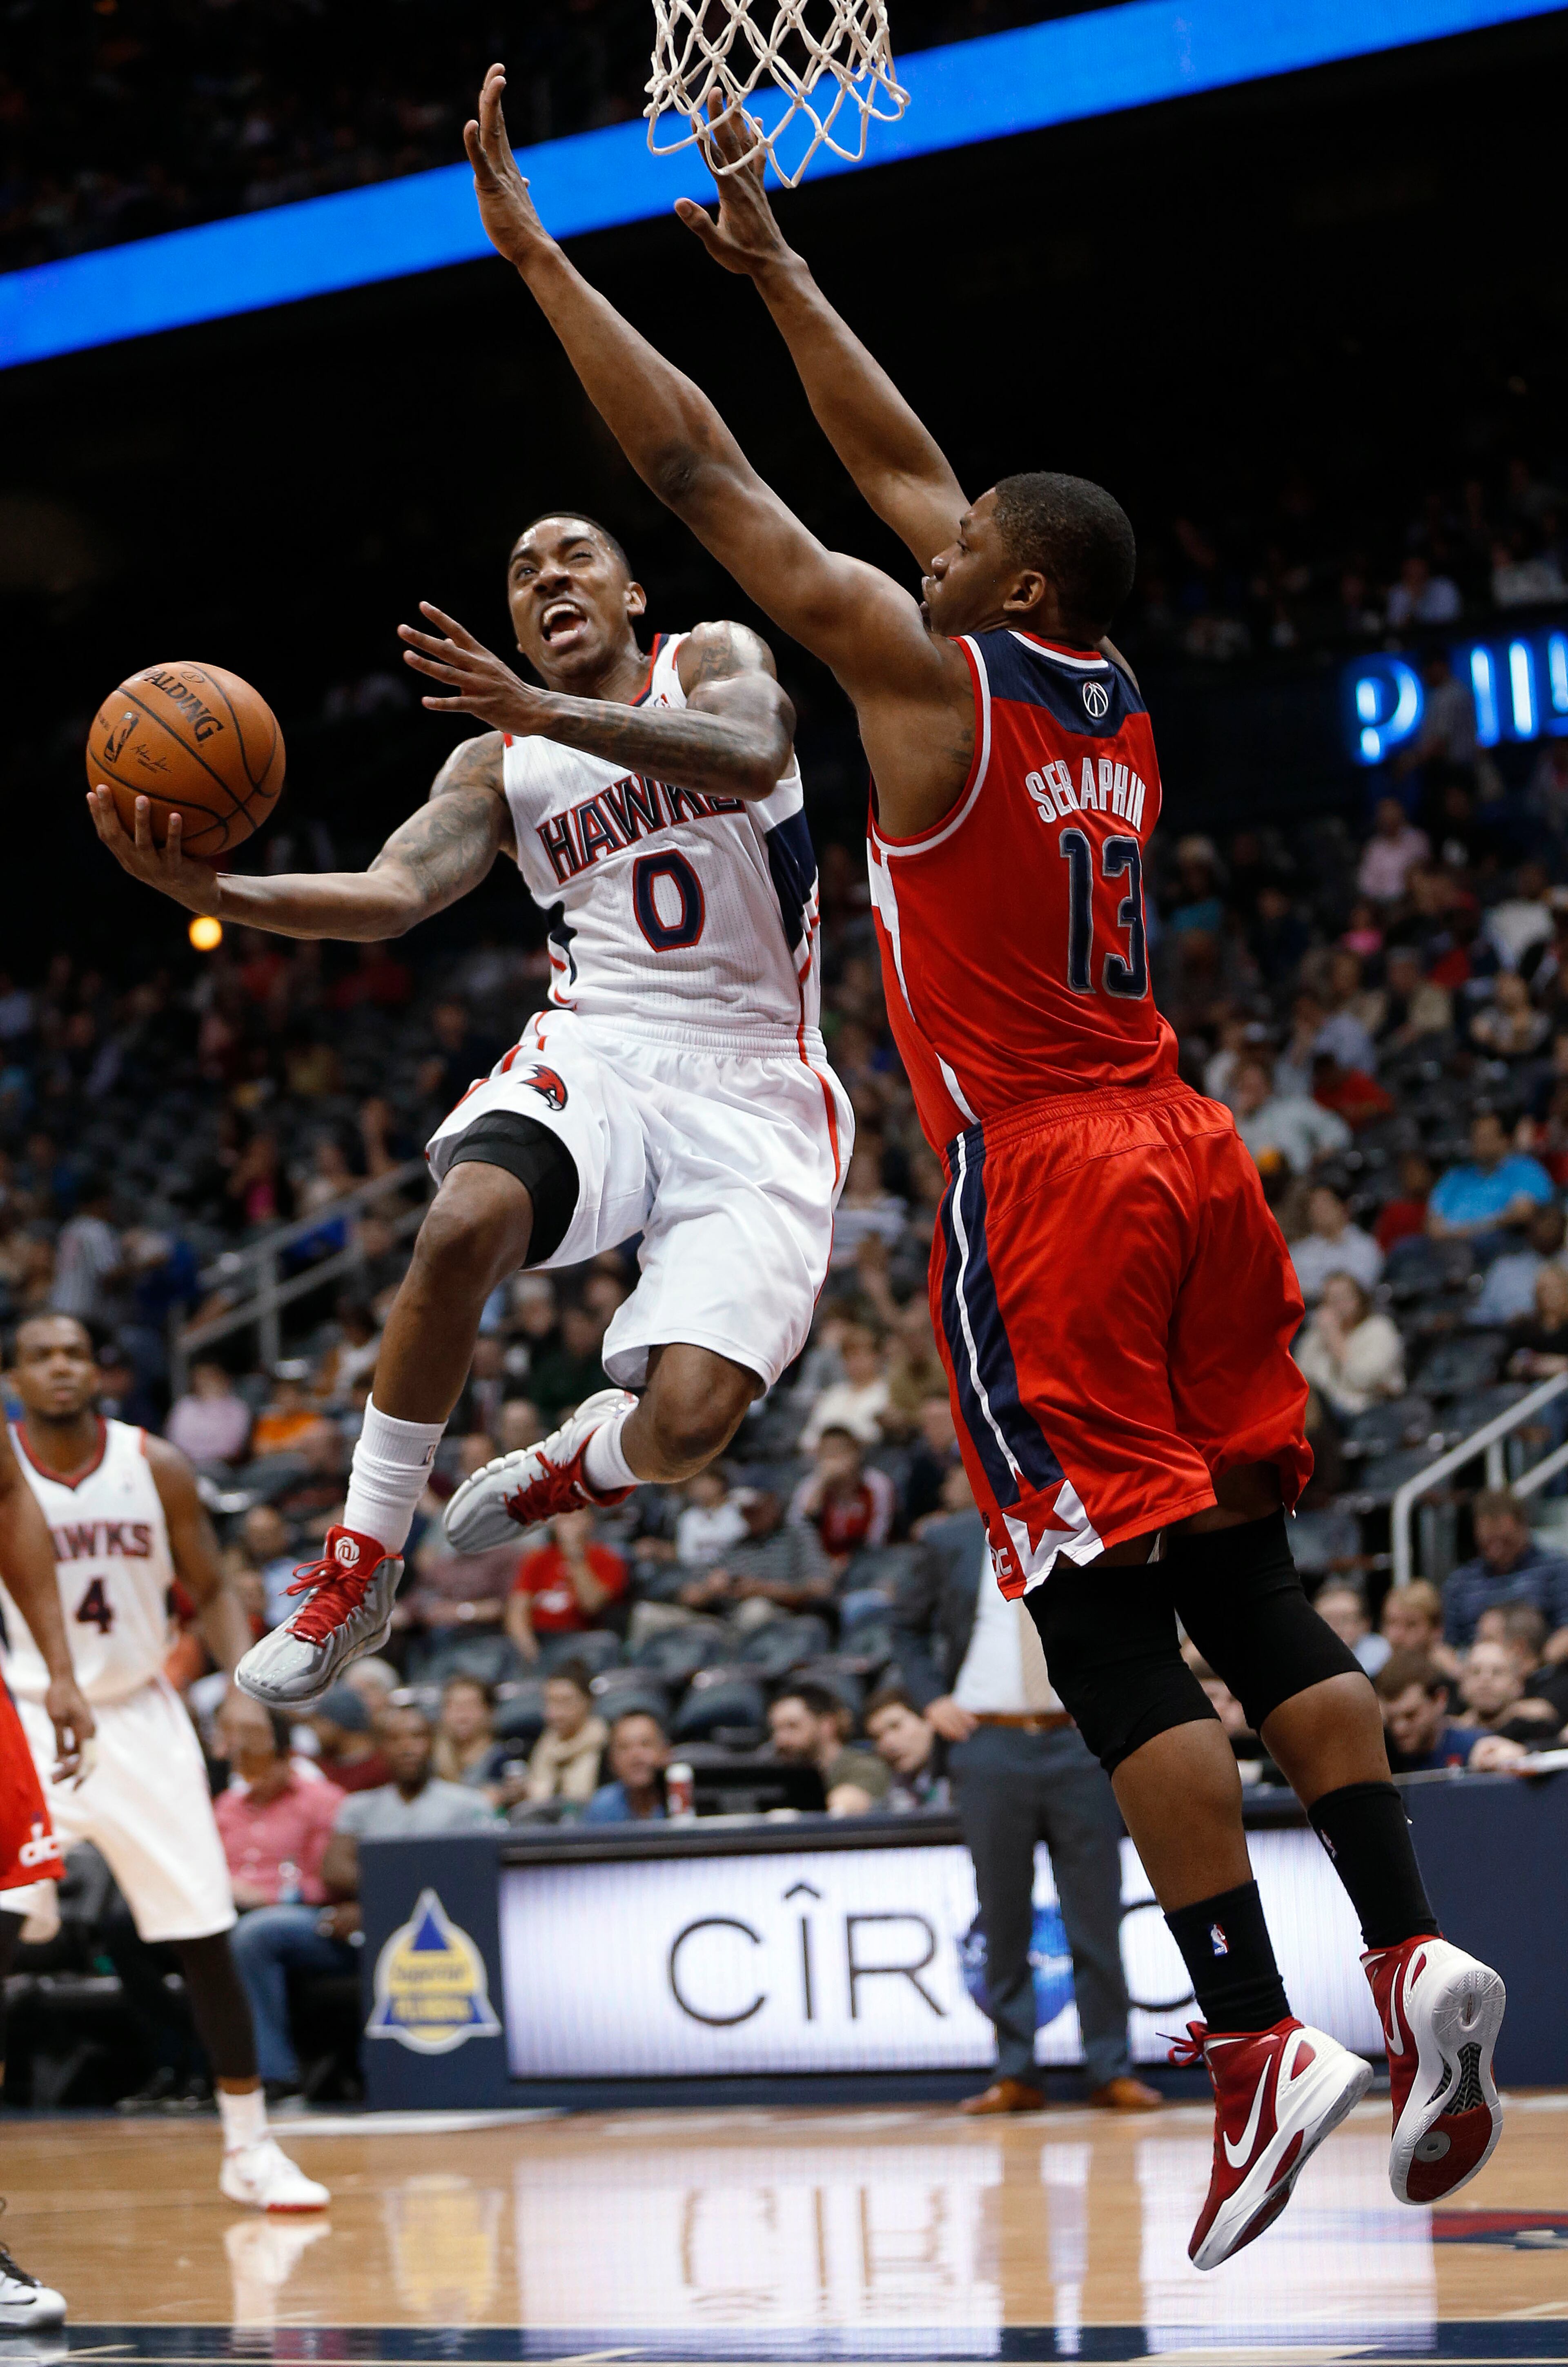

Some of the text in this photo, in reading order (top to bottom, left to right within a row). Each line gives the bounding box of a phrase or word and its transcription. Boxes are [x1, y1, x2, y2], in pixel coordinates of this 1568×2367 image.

[1025, 757, 1147, 833] SERAPHIN
[633, 848, 706, 953] 0
[1059, 827, 1148, 1001] 13
[75, 1577, 113, 1634] 4
